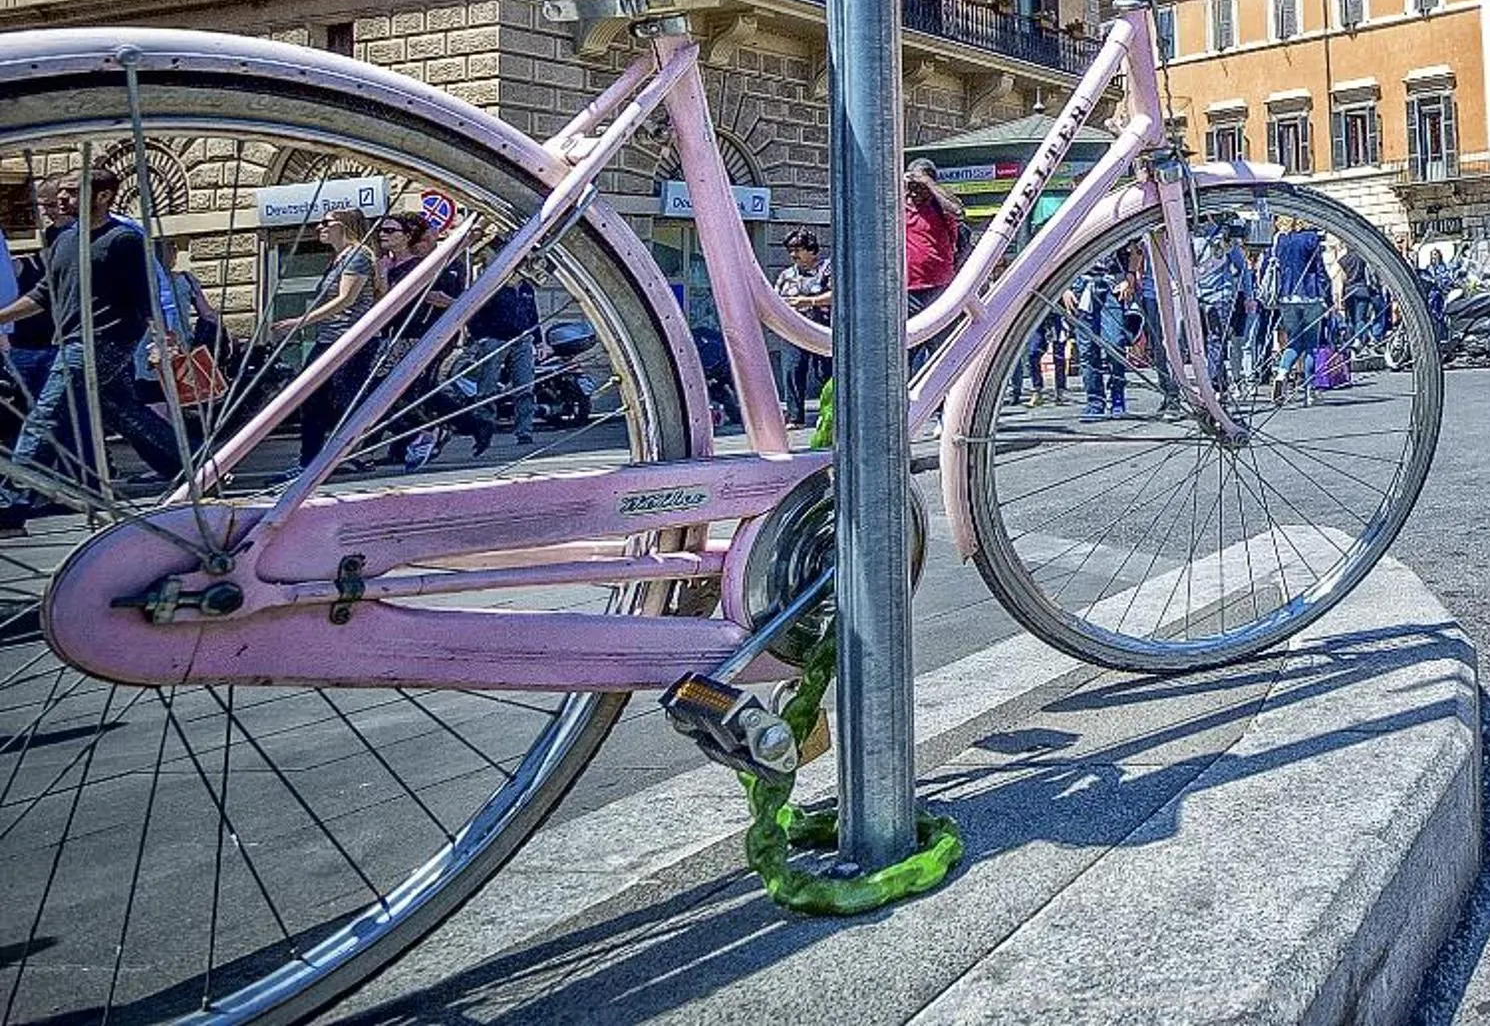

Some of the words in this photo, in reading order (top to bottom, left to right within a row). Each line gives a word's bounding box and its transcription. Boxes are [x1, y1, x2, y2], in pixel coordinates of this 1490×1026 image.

[1004, 105, 1087, 228] WELTER
[265, 200, 319, 216] Deutsche
[322, 197, 353, 211] Bank
